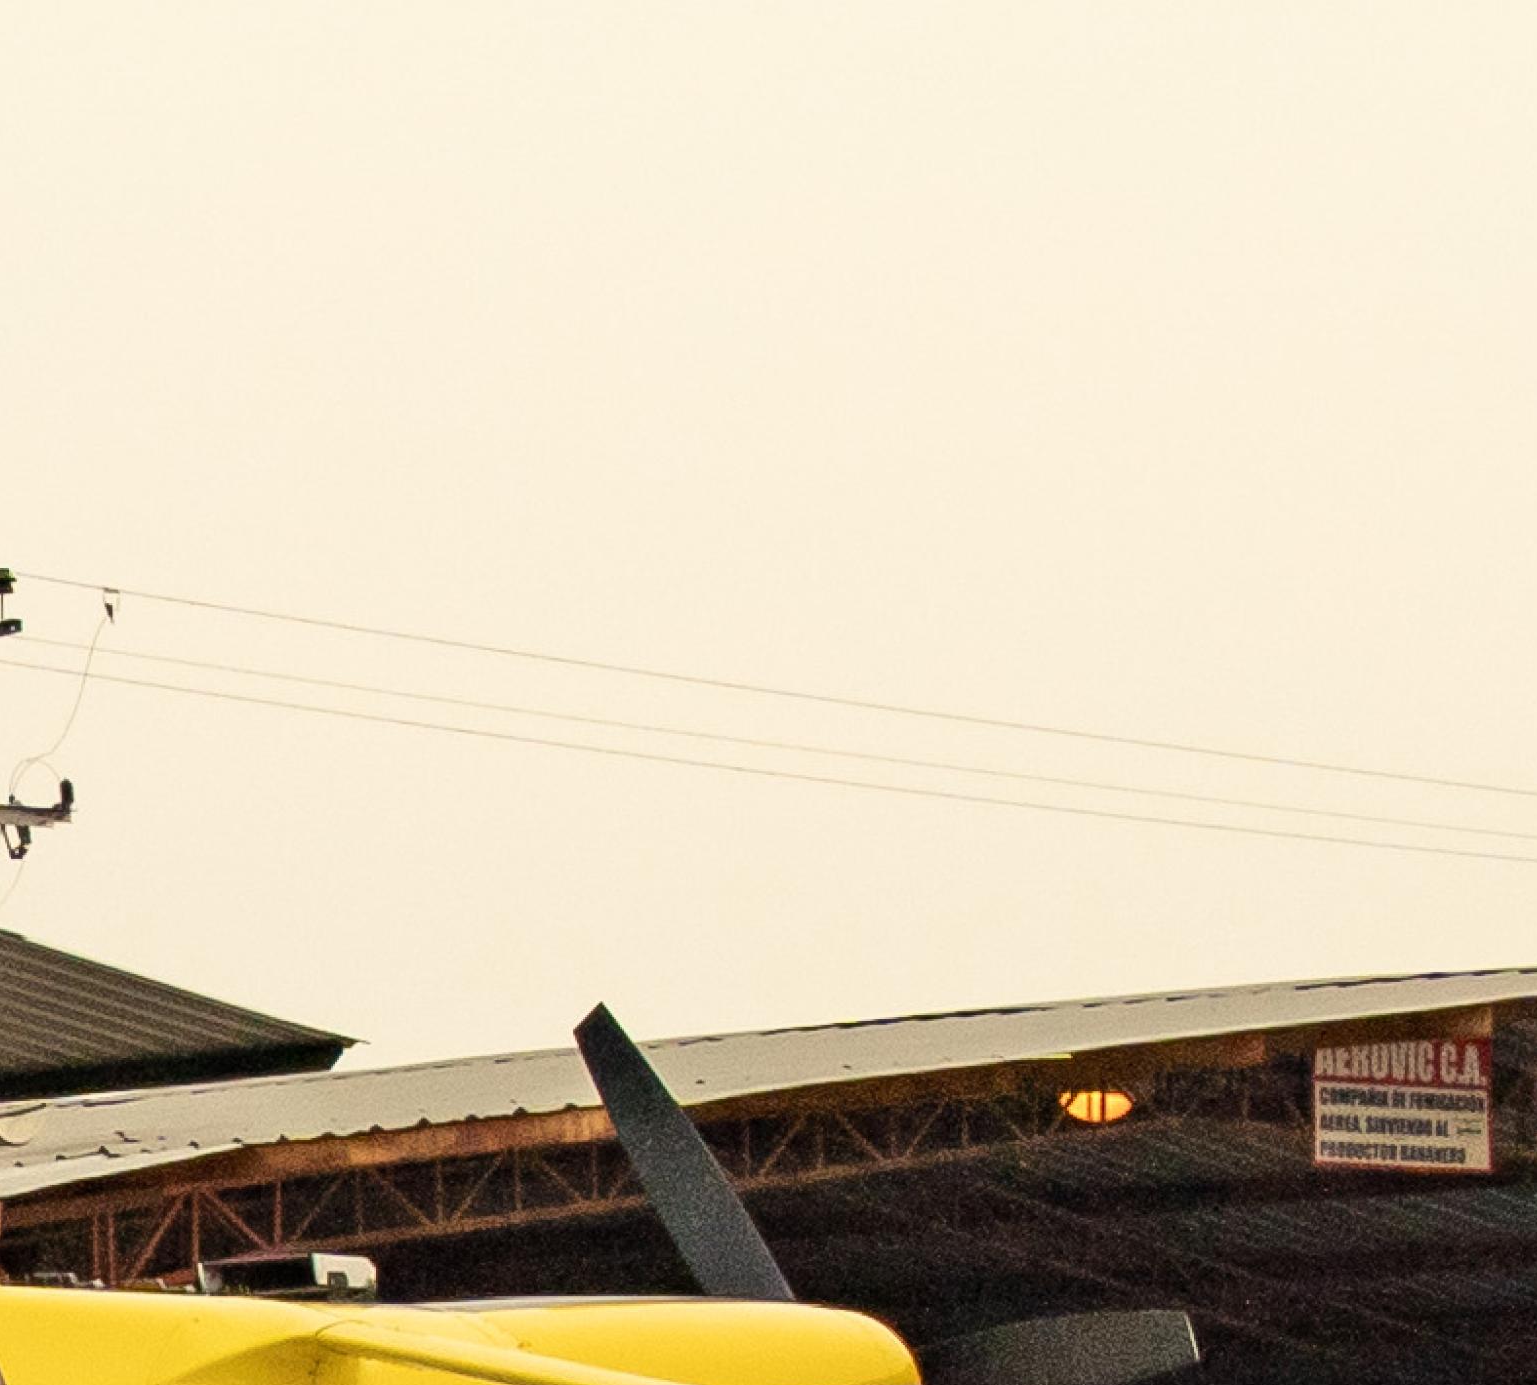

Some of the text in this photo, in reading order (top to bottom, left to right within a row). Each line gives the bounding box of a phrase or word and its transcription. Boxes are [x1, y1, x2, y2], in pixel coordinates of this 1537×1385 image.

[1439, 1042, 1488, 1086] C.A.
[1391, 1090, 1406, 1108] DE
[1319, 1140, 1397, 1161] PRODUCTOR
